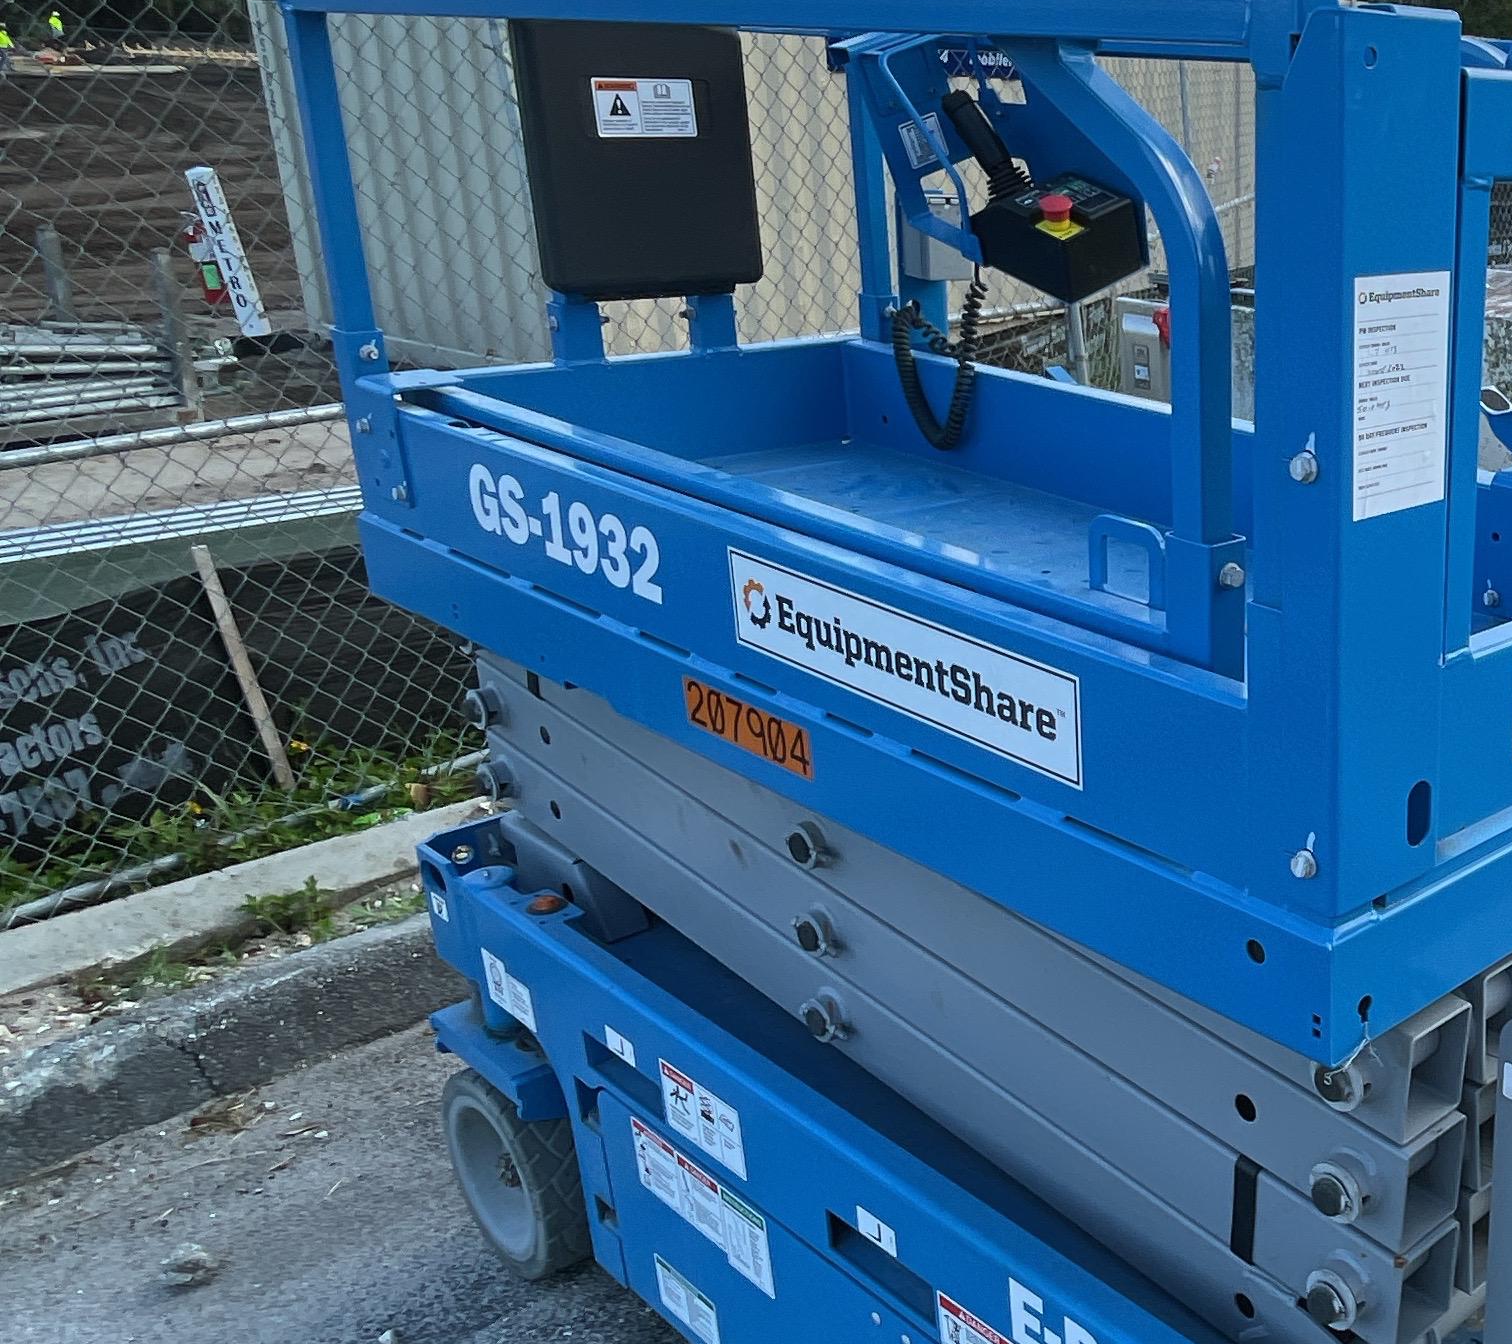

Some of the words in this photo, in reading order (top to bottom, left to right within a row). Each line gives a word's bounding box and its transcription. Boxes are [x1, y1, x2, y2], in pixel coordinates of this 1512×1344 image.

[1369, 288, 1440, 304] EquipmentShare
[469, 463, 663, 605] GS-1932
[686, 680, 810, 776] 207904
